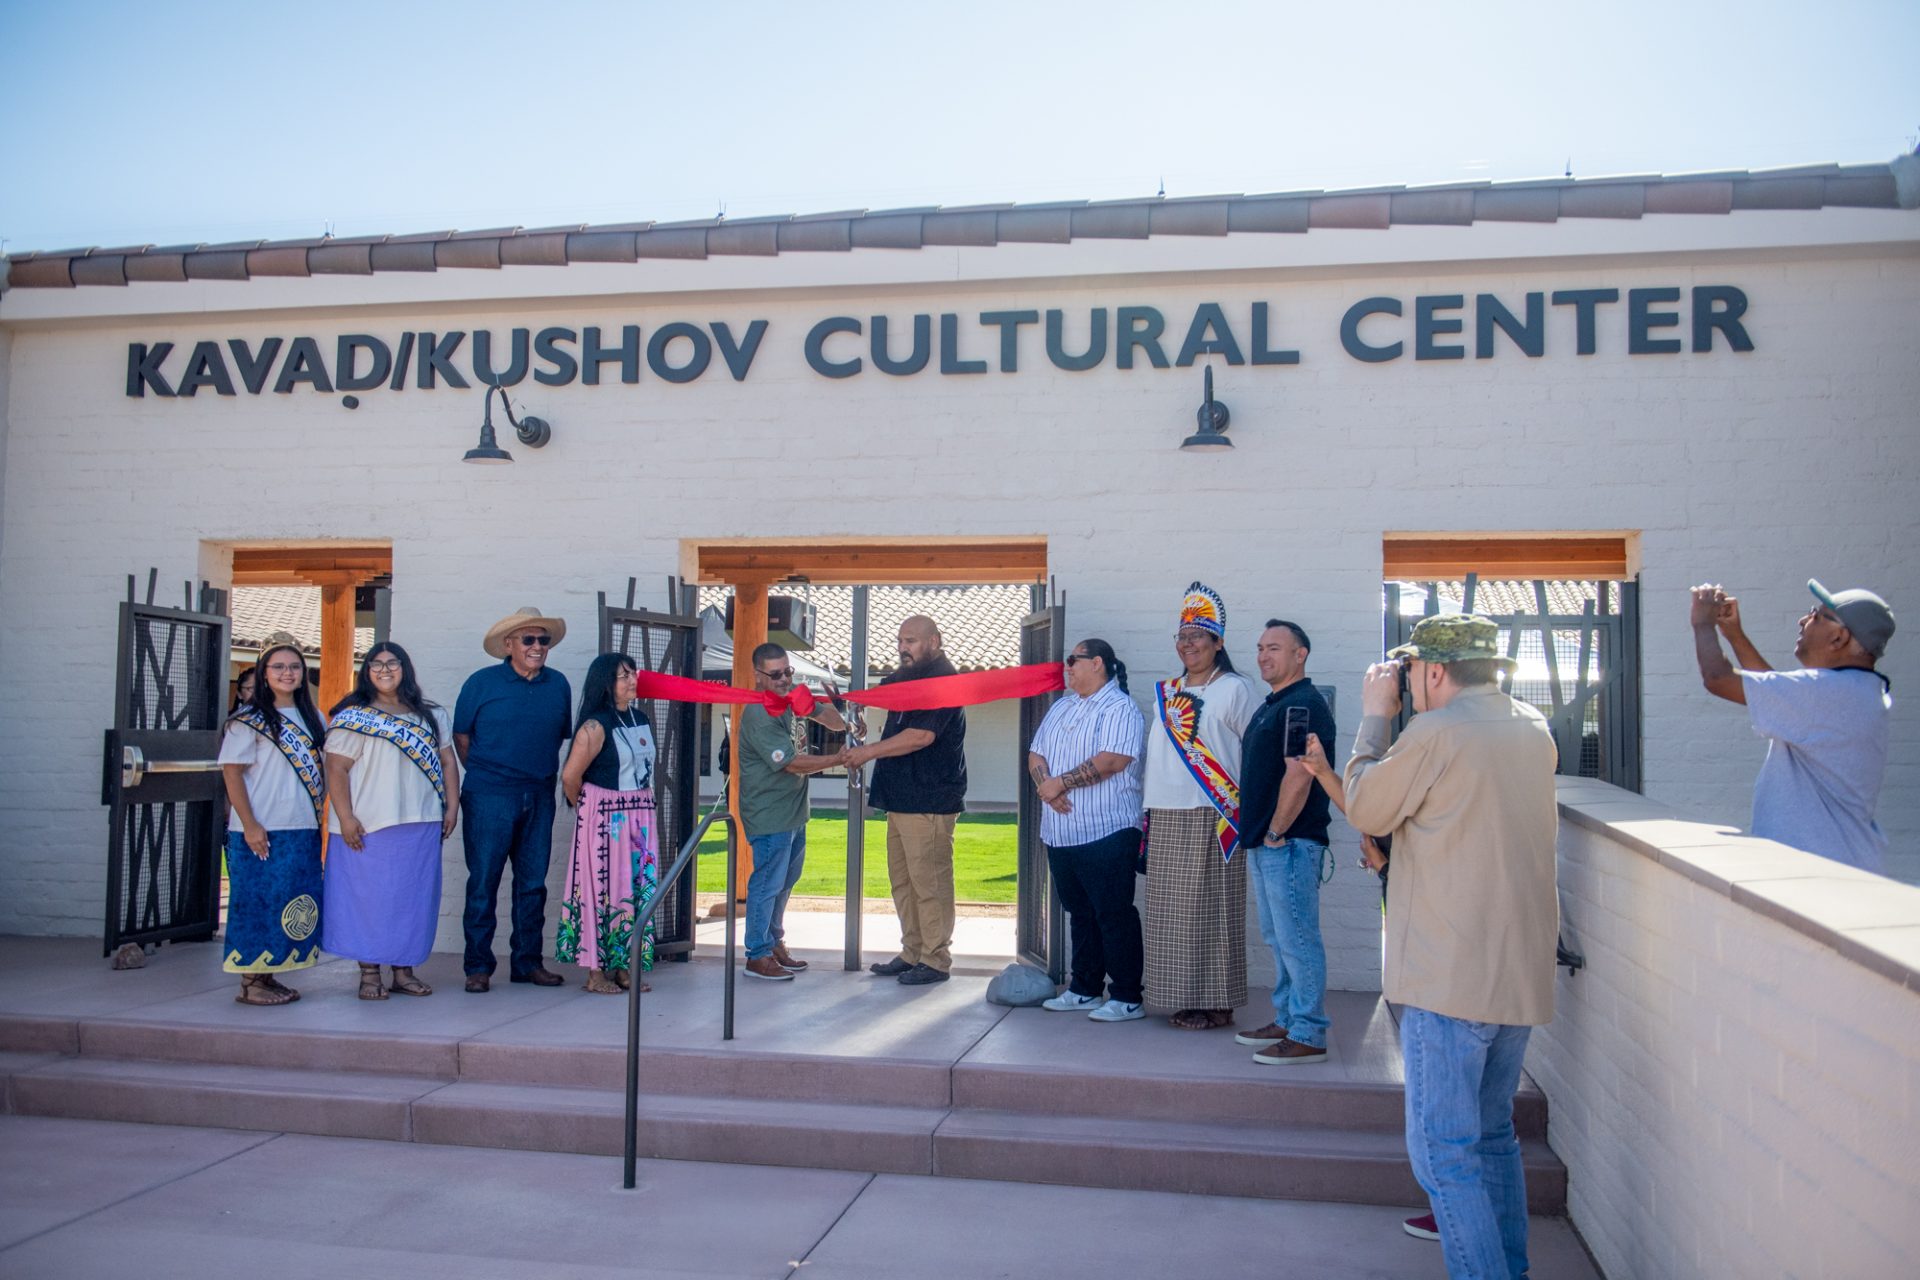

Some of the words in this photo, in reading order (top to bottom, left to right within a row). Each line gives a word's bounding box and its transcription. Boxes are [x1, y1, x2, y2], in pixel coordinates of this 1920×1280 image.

[804, 301, 1300, 379] CULTURAL
[1339, 285, 1755, 363] CENTER
[355, 711, 376, 720] MISS
[355, 717, 380, 728] RIVER
[383, 719, 397, 728] 1ST
[301, 753, 321, 788] SALT
[1183, 741, 1213, 777] Arizona
